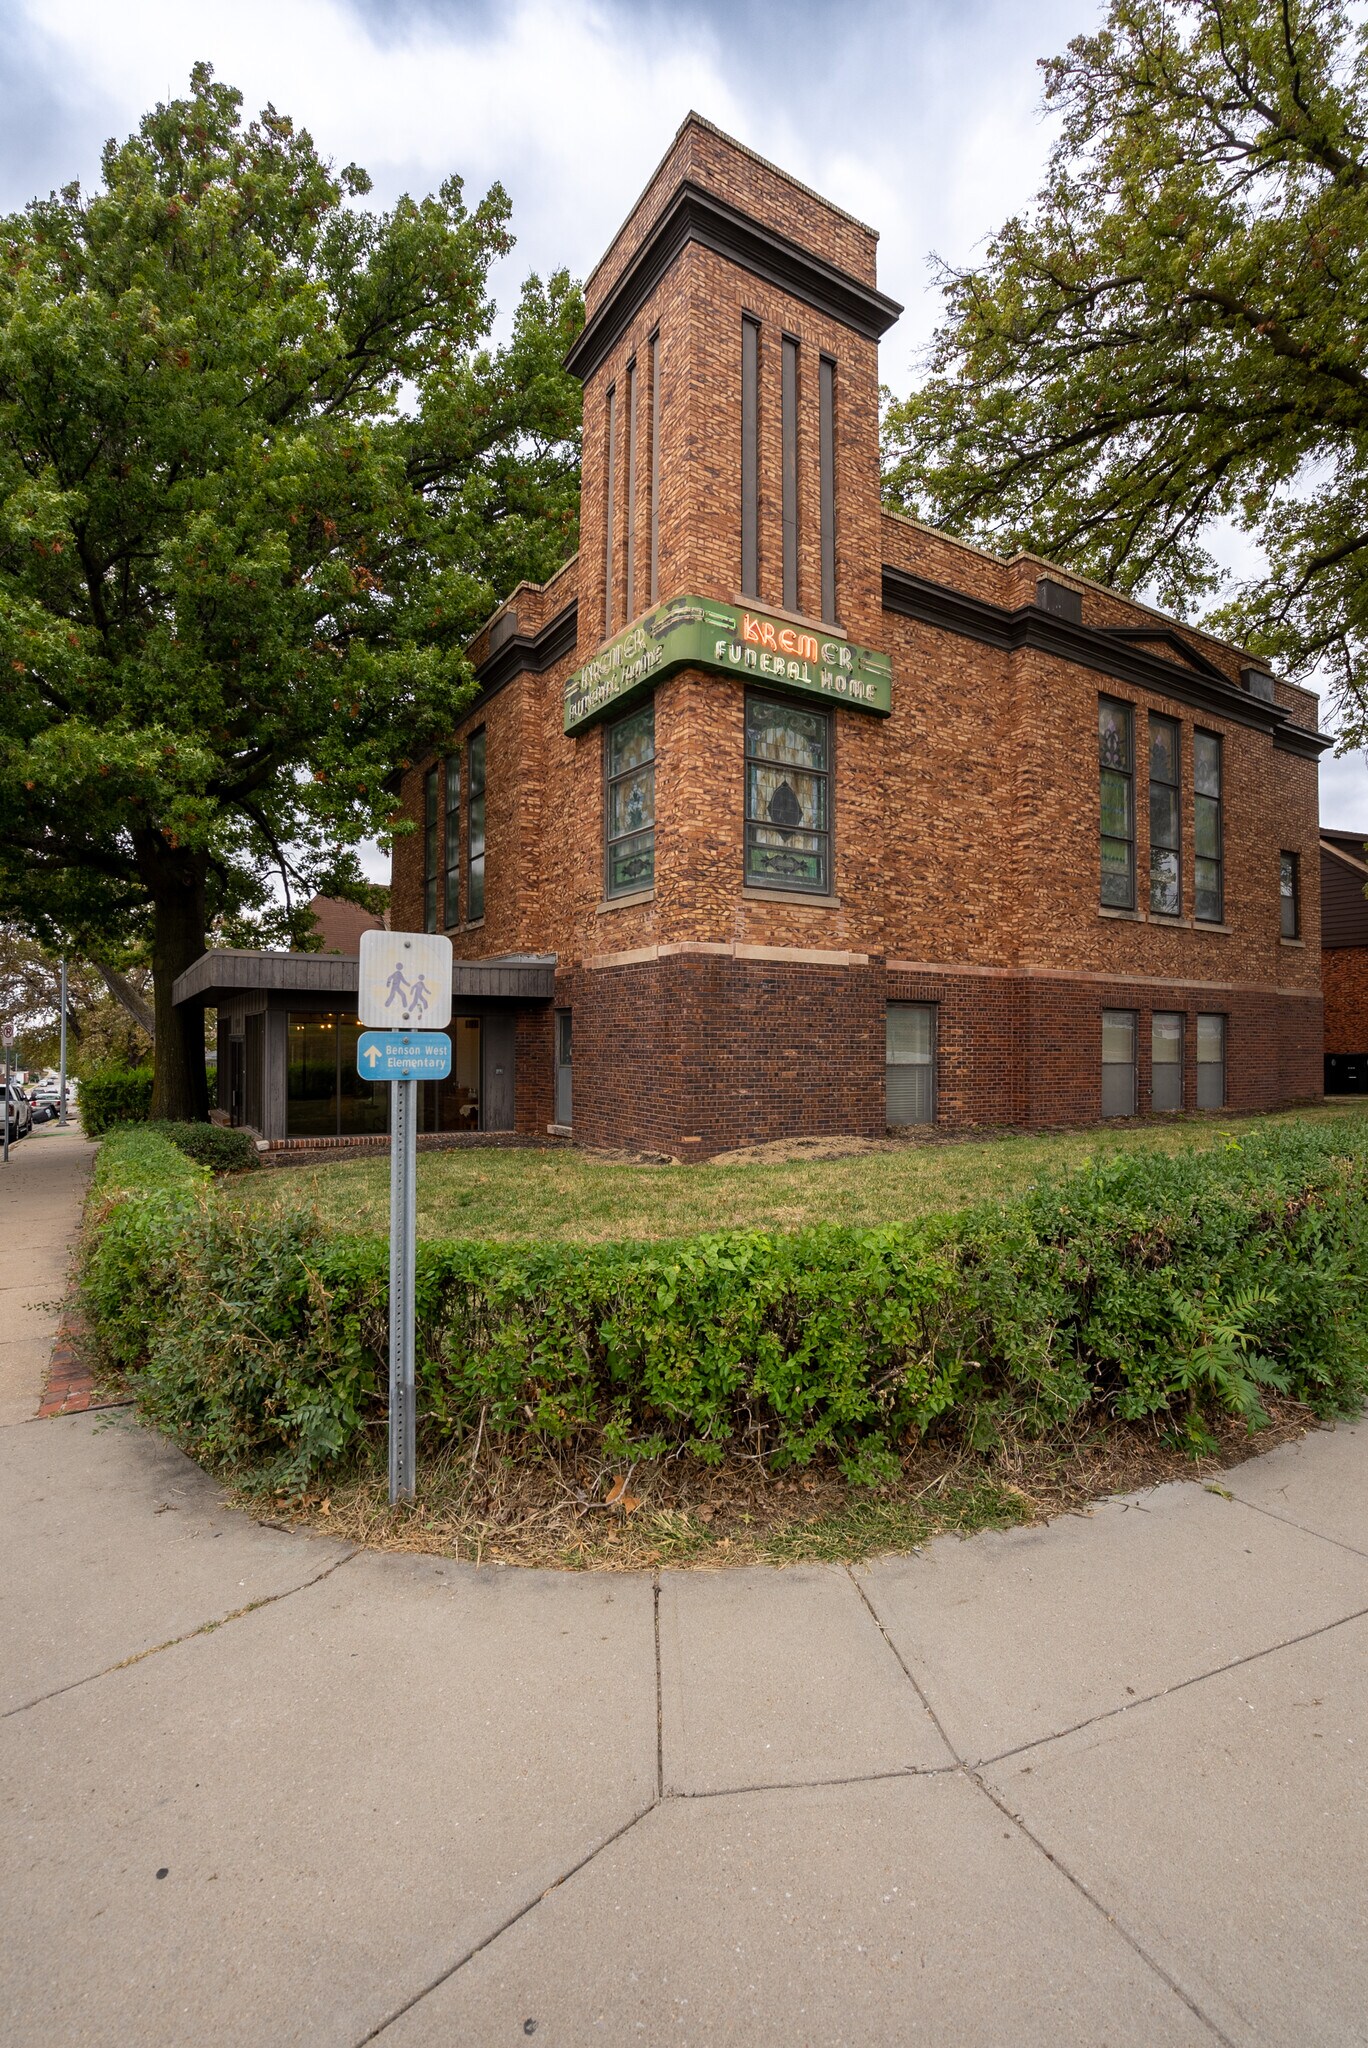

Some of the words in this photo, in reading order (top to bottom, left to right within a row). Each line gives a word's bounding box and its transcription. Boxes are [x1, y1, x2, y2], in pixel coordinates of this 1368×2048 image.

[743, 613, 855, 670] KREMER
[715, 640, 812, 684] FUNERAL
[821, 670, 878, 702] HOME
[386, 1045, 420, 1056] Benson
[425, 1046, 447, 1056] West
[387, 1057, 446, 1070] Elementary
